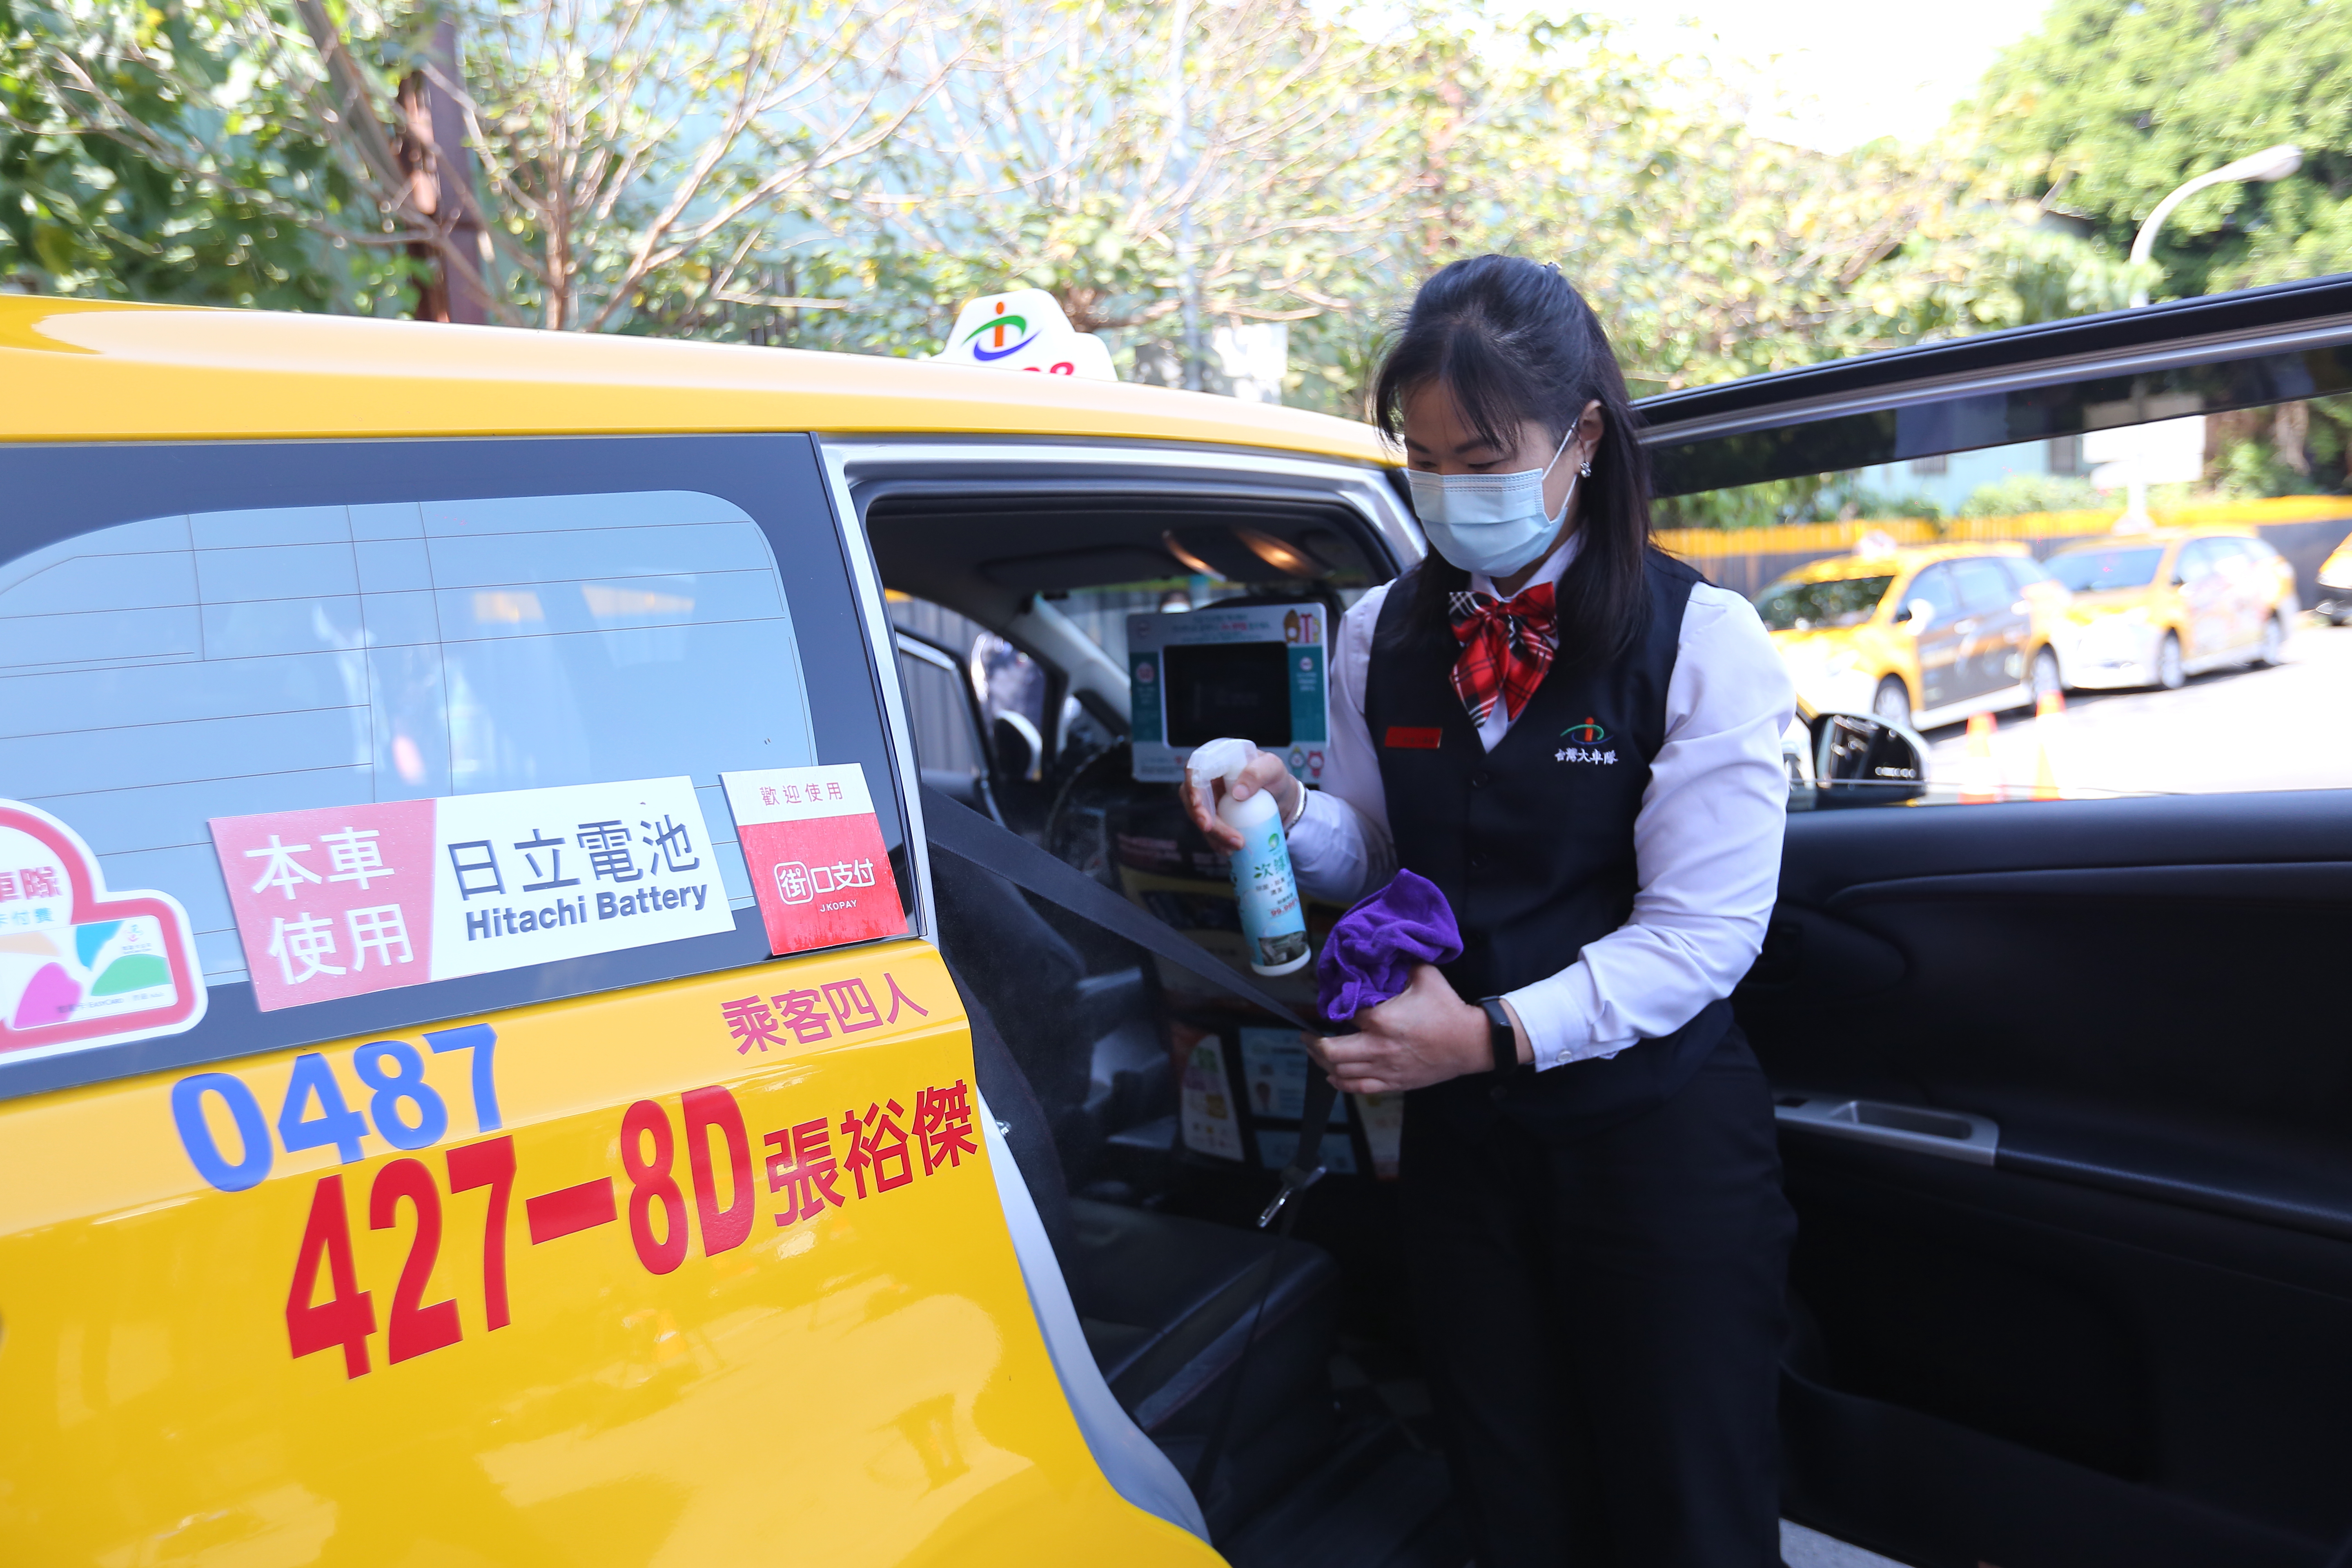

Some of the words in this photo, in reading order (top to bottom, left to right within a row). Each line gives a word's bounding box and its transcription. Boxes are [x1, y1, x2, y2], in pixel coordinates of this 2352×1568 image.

[1554, 747, 1619, 765] 台灣大車隊
[759, 782, 844, 806] 歡迎使用
[245, 826, 395, 900] 本車
[448, 814, 700, 901] 日立電池
[775, 858, 876, 902] 街口支付
[466, 895, 588, 941] Hitachi
[596, 884, 708, 920] Battery
[820, 899, 858, 913] JKOPAY
[268, 903, 414, 985] 使用
[720, 973, 929, 1055] 乘客四人
[171, 1022, 503, 1193] 0487
[285, 1085, 755, 1380] 427-8D
[763, 1079, 978, 1227] 張裕傑
